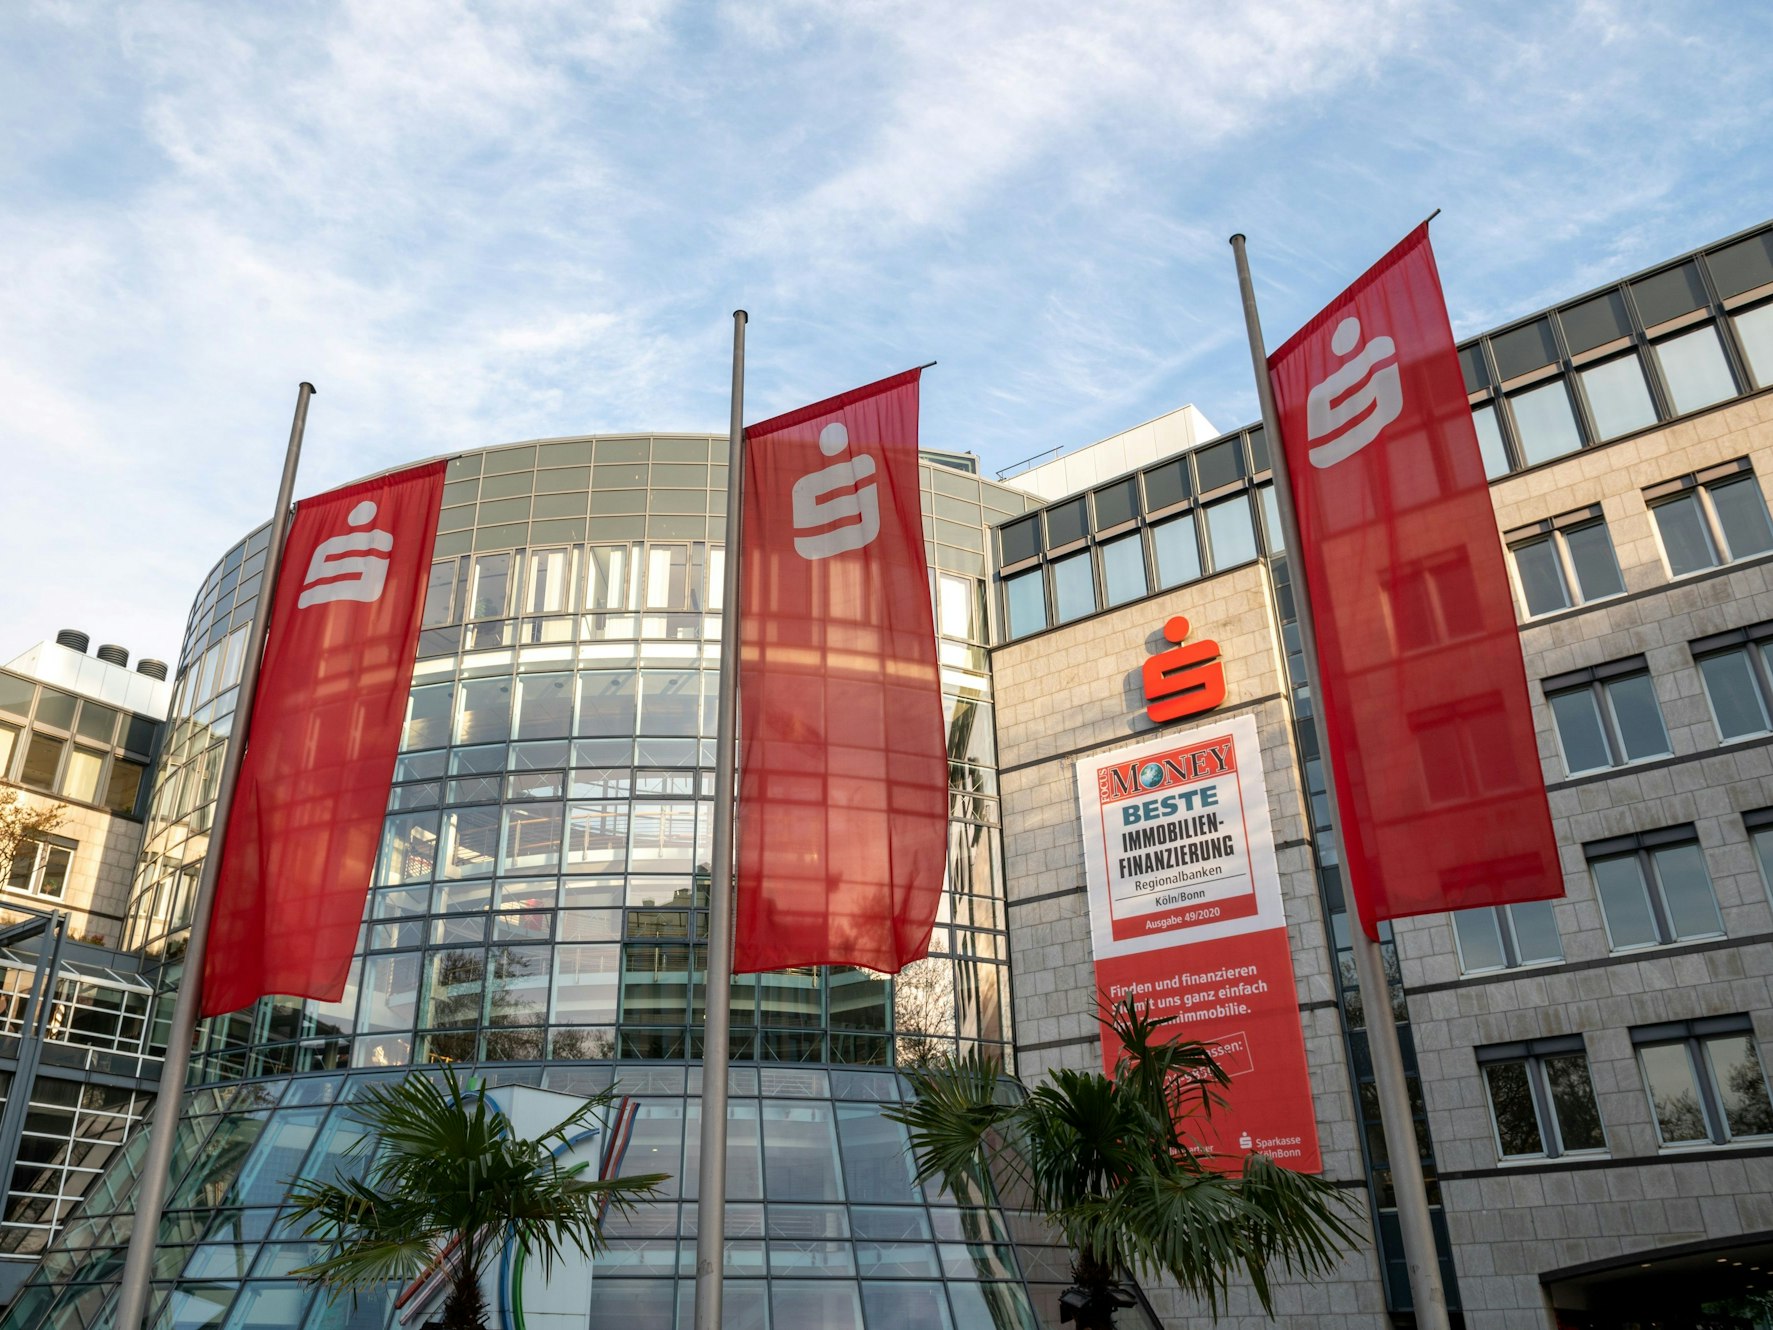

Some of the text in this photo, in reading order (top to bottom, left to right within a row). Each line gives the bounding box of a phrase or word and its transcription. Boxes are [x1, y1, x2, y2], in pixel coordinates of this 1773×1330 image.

[1100, 768, 1110, 803] FOCUS
[1122, 785, 1219, 826] BESTE
[1122, 812, 1224, 853] IMMOBILIEN-
[1119, 834, 1235, 879] FINANZIERUNG
[1135, 866, 1223, 891] Regionalbanken
[1155, 890, 1206, 907] Köln/Bonn
[1146, 907, 1221, 929] Ausgabe 49/2020
[1110, 965, 1257, 997] Finden und finanzieren
[1158, 995, 1181, 1009] uns
[1184, 990, 1216, 1007] ganz
[1218, 980, 1268, 999] einfach
[1256, 1135, 1301, 1149] Sparkasse
